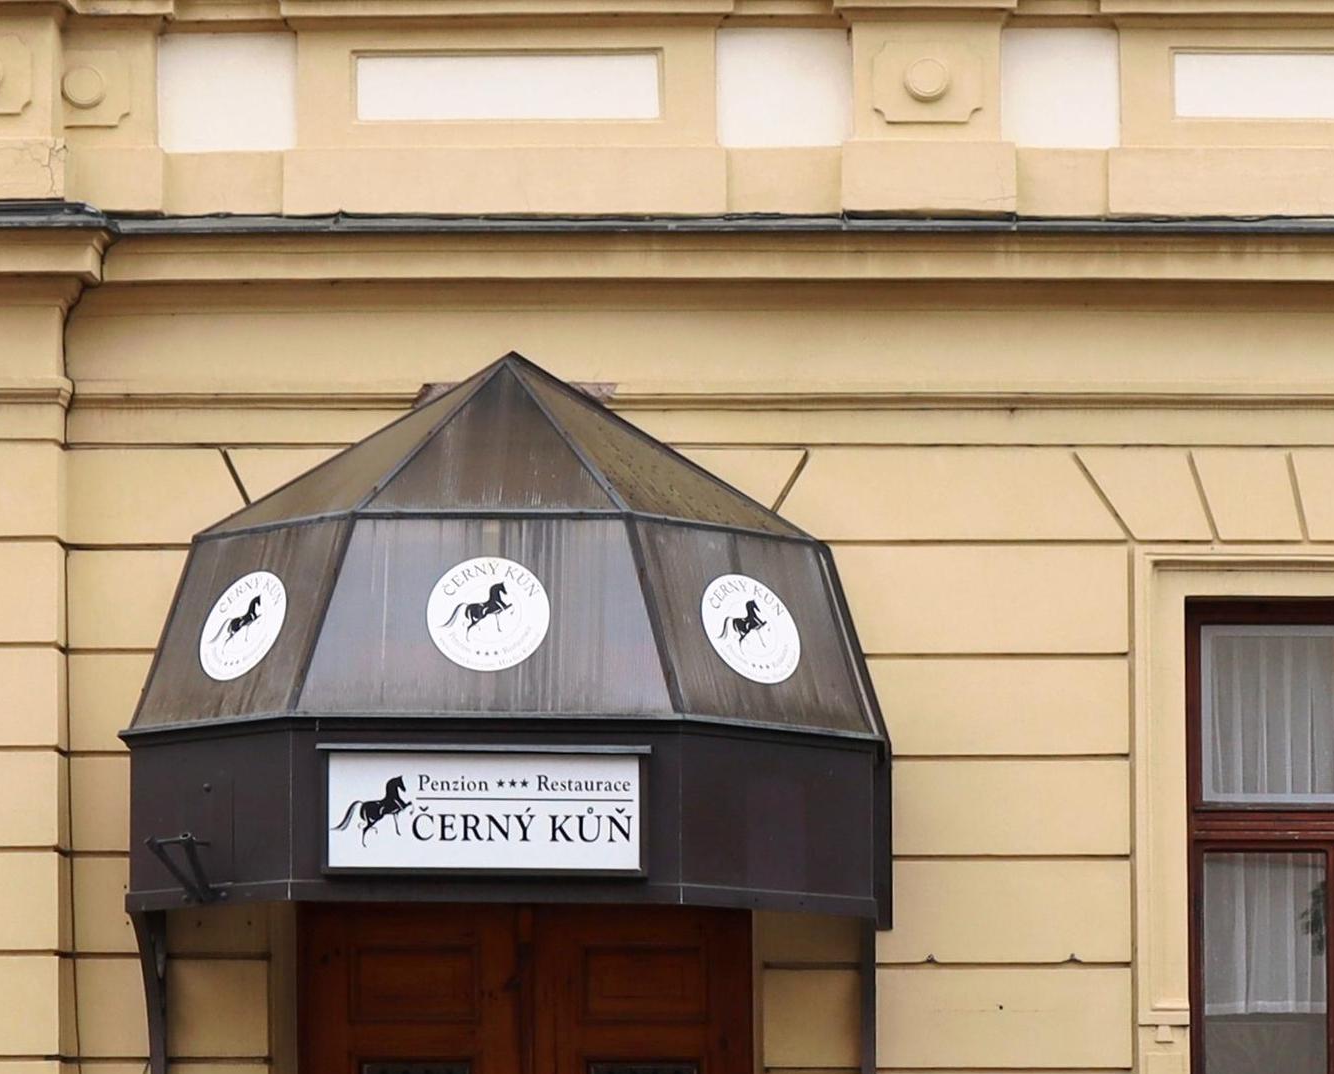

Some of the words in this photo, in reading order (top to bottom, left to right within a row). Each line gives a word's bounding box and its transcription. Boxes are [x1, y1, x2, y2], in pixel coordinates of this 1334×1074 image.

[418, 774, 489, 792] Penzion
[537, 774, 631, 792] Restaurace
[412, 805, 535, 842] ČERNÝ
[550, 805, 633, 843] KŮŇ
